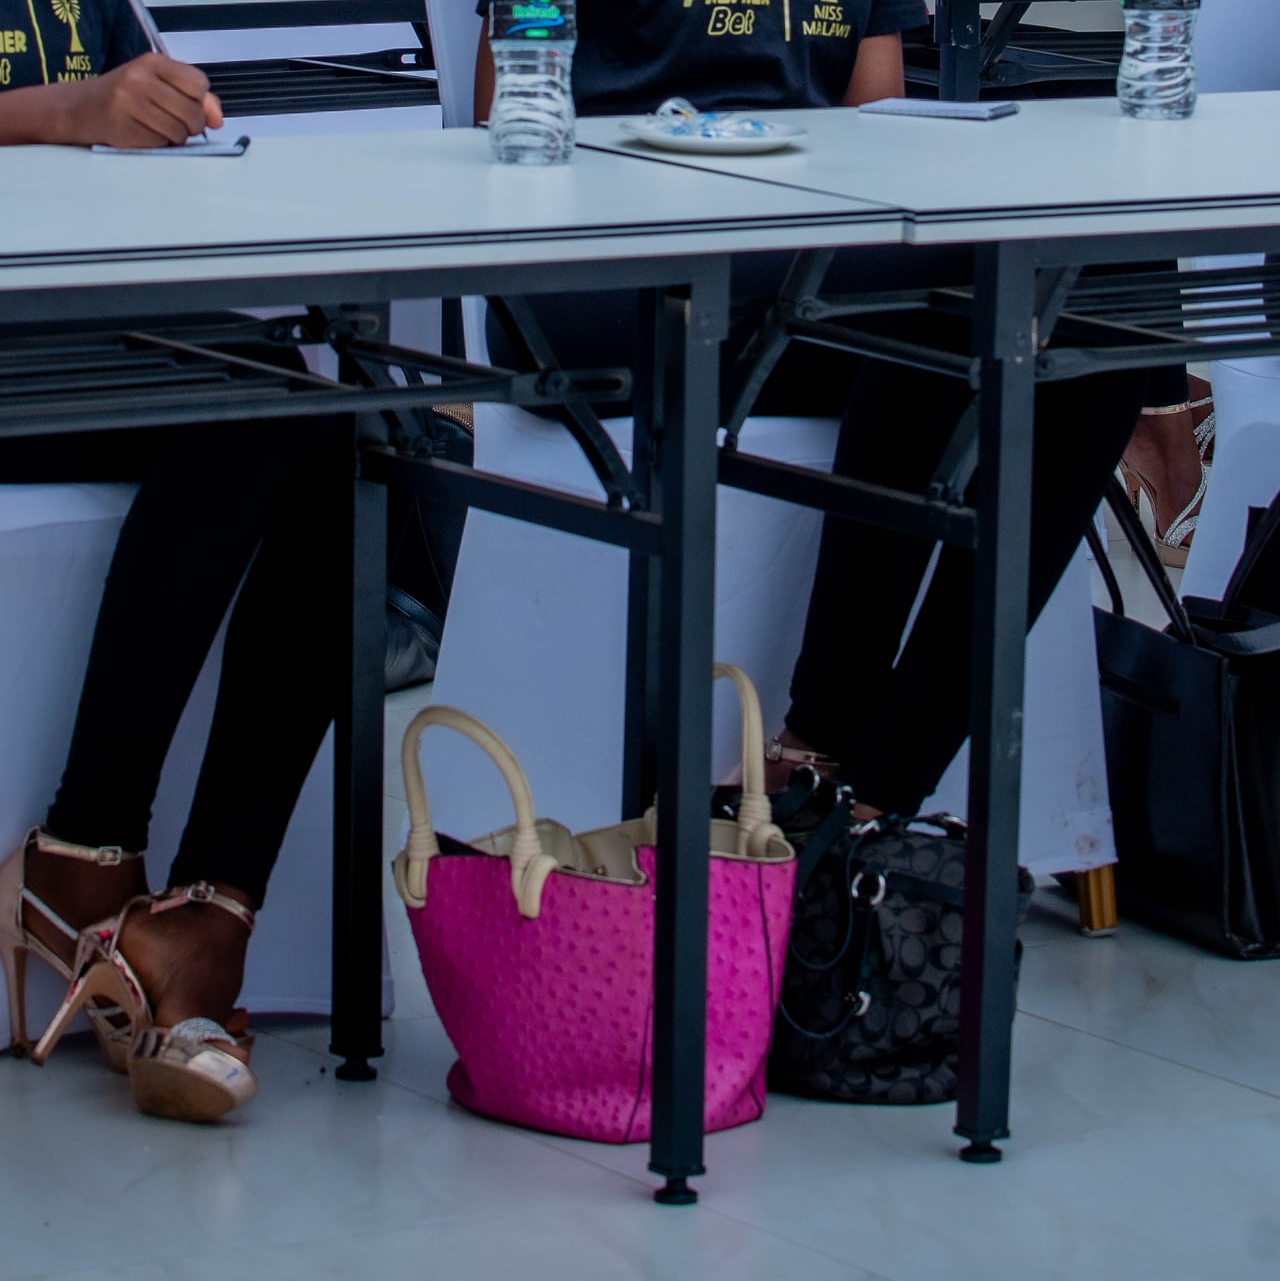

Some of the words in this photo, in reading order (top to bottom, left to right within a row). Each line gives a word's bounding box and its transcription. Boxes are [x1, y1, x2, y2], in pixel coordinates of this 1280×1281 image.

[707, 6, 755, 36] Bet
[813, 4, 844, 22] MISS
[802, 20, 851, 38] MALAWI
[65, 55, 92, 71] MISS
